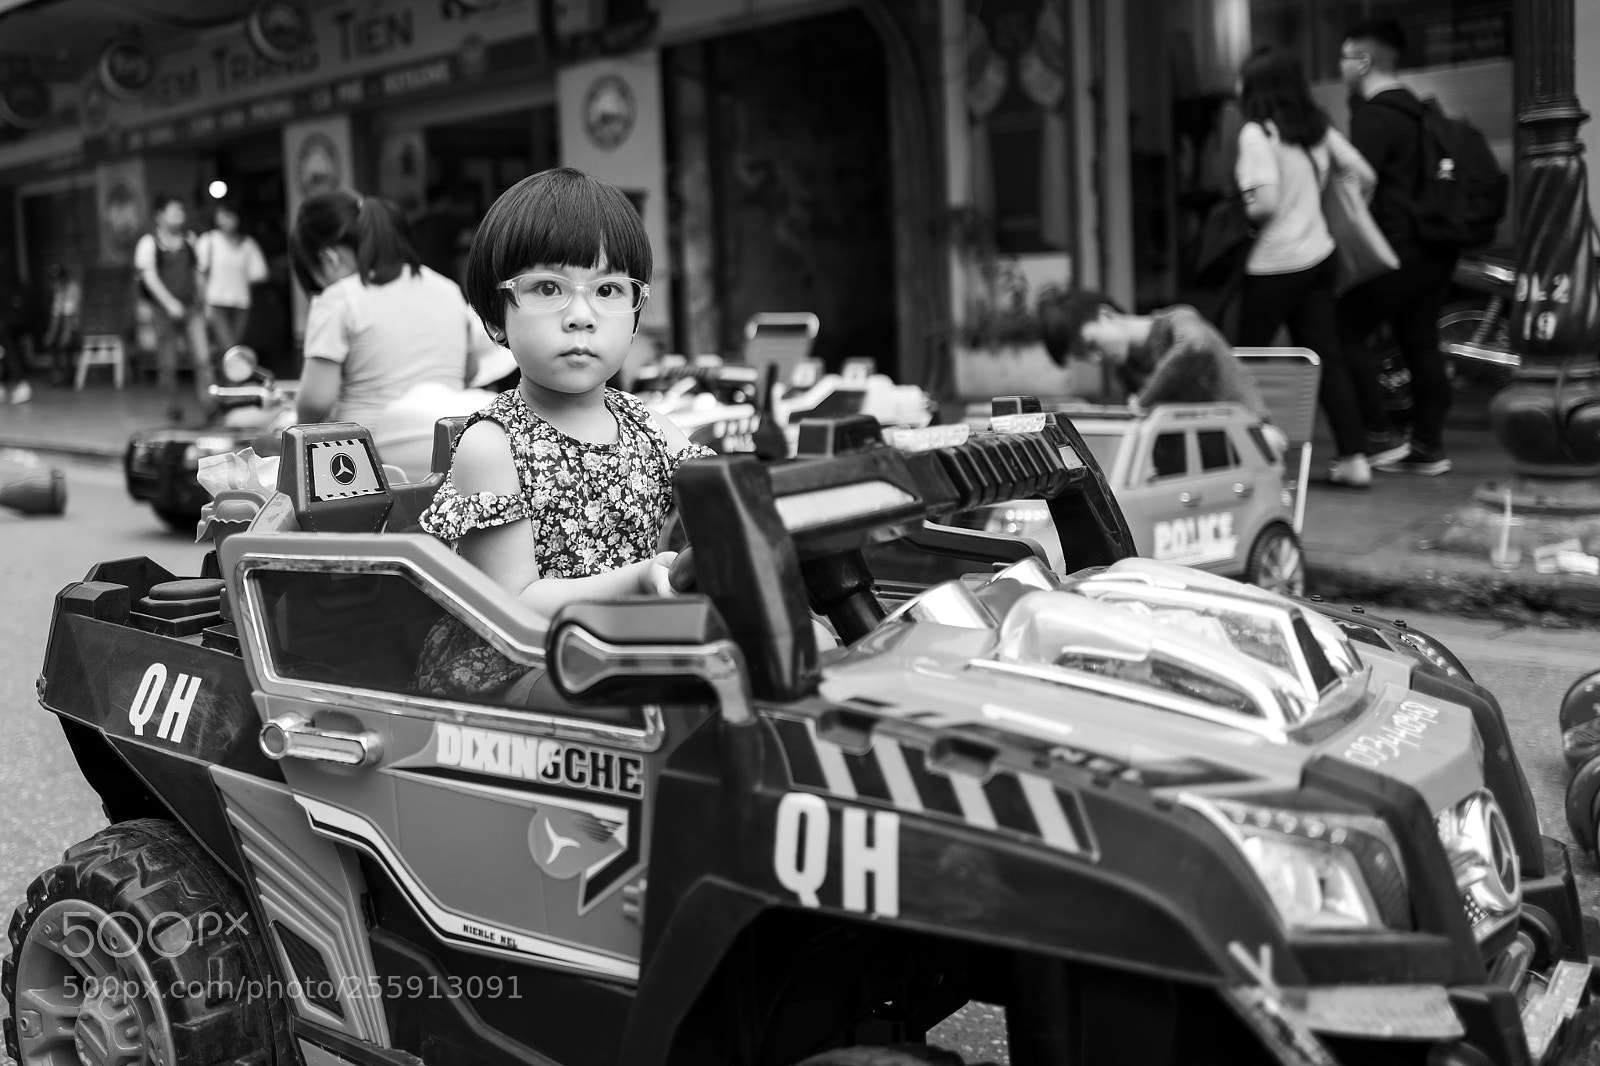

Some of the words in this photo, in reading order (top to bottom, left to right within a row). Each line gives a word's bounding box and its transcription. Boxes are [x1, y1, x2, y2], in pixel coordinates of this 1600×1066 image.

[1523, 310, 1557, 340] 19
[1153, 511, 1234, 557] POLICE
[129, 662, 202, 743] QH
[436, 723, 643, 798] DIXINGCHE
[775, 791, 900, 919] QH
